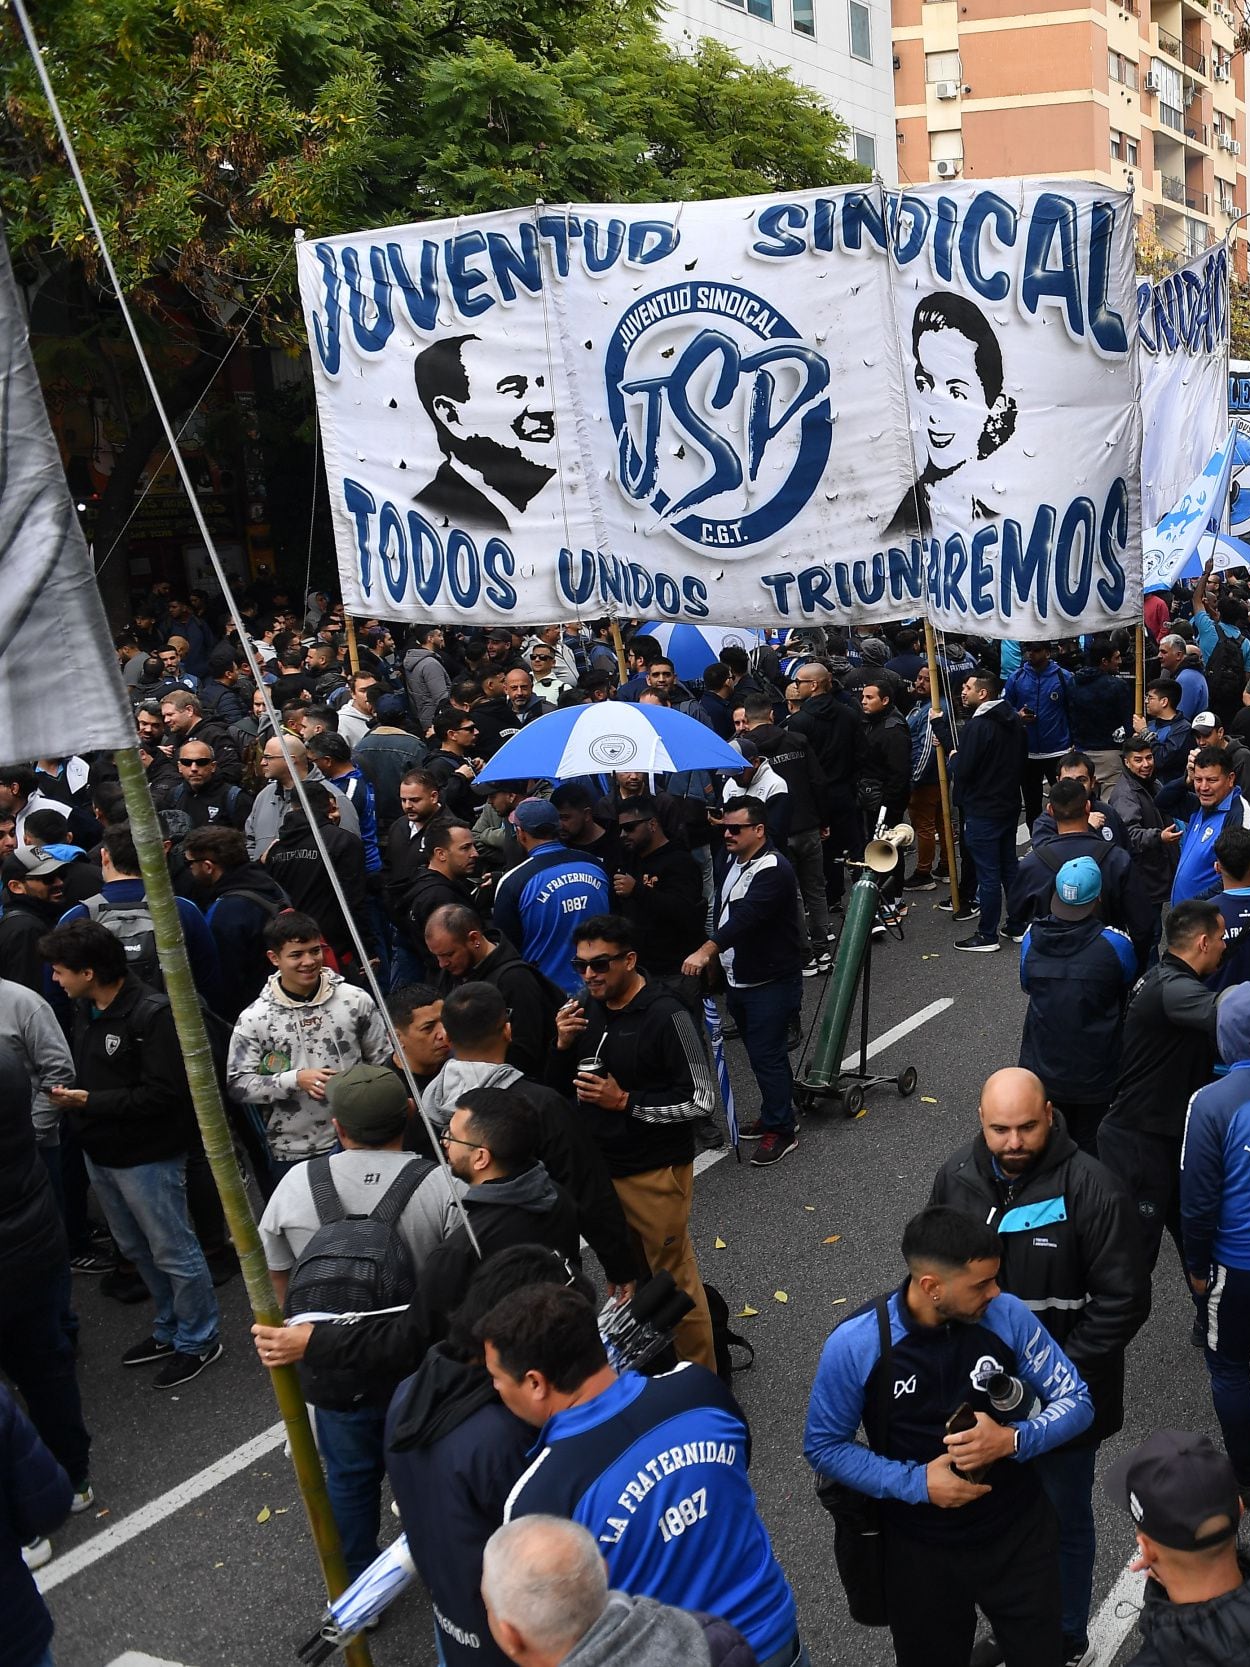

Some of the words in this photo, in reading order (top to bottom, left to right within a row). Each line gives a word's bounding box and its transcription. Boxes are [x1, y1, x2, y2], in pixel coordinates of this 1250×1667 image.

[313, 215, 681, 375] JUVENTUD
[752, 190, 1128, 352] SINDICAL
[622, 288, 692, 351] JUVENTUD
[697, 287, 779, 339] SINDICAL
[343, 478, 518, 609] TODOS
[559, 548, 710, 618] UNIDOS
[701, 523, 749, 545] C.G.T.
[536, 891, 551, 904] LA
[546, 872, 602, 893] FRATERNIDAD
[561, 895, 588, 914] 1887
[599, 1517, 630, 1544] LA
[617, 1440, 737, 1514] FRATERNIDAD
[658, 1487, 709, 1543] 1887
